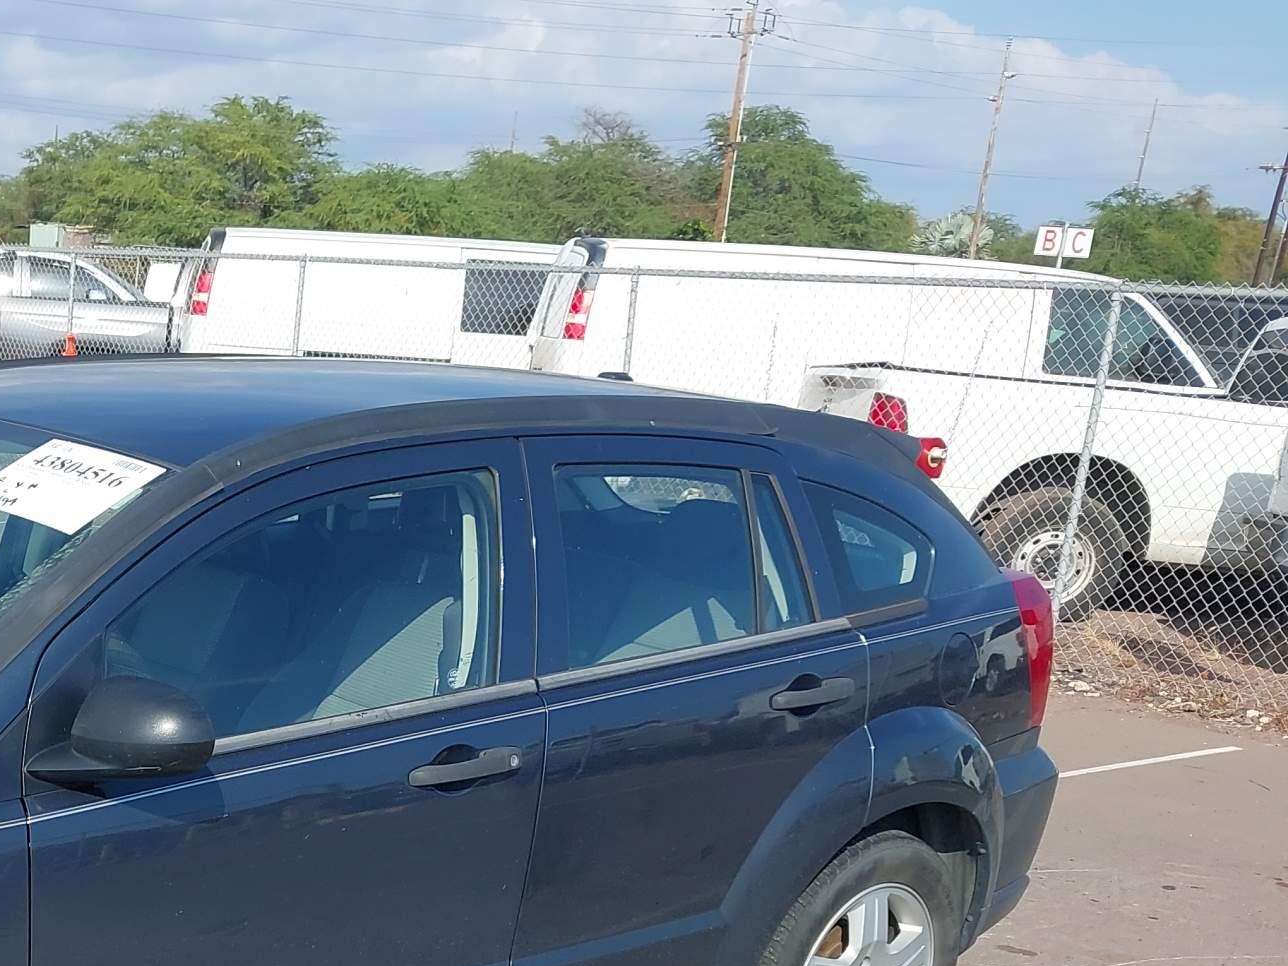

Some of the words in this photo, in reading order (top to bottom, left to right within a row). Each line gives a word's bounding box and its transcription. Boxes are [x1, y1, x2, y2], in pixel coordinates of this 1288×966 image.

[1042, 229, 1057, 251] B
[1072, 231, 1087, 254] C
[33, 455, 129, 489] 43804516
